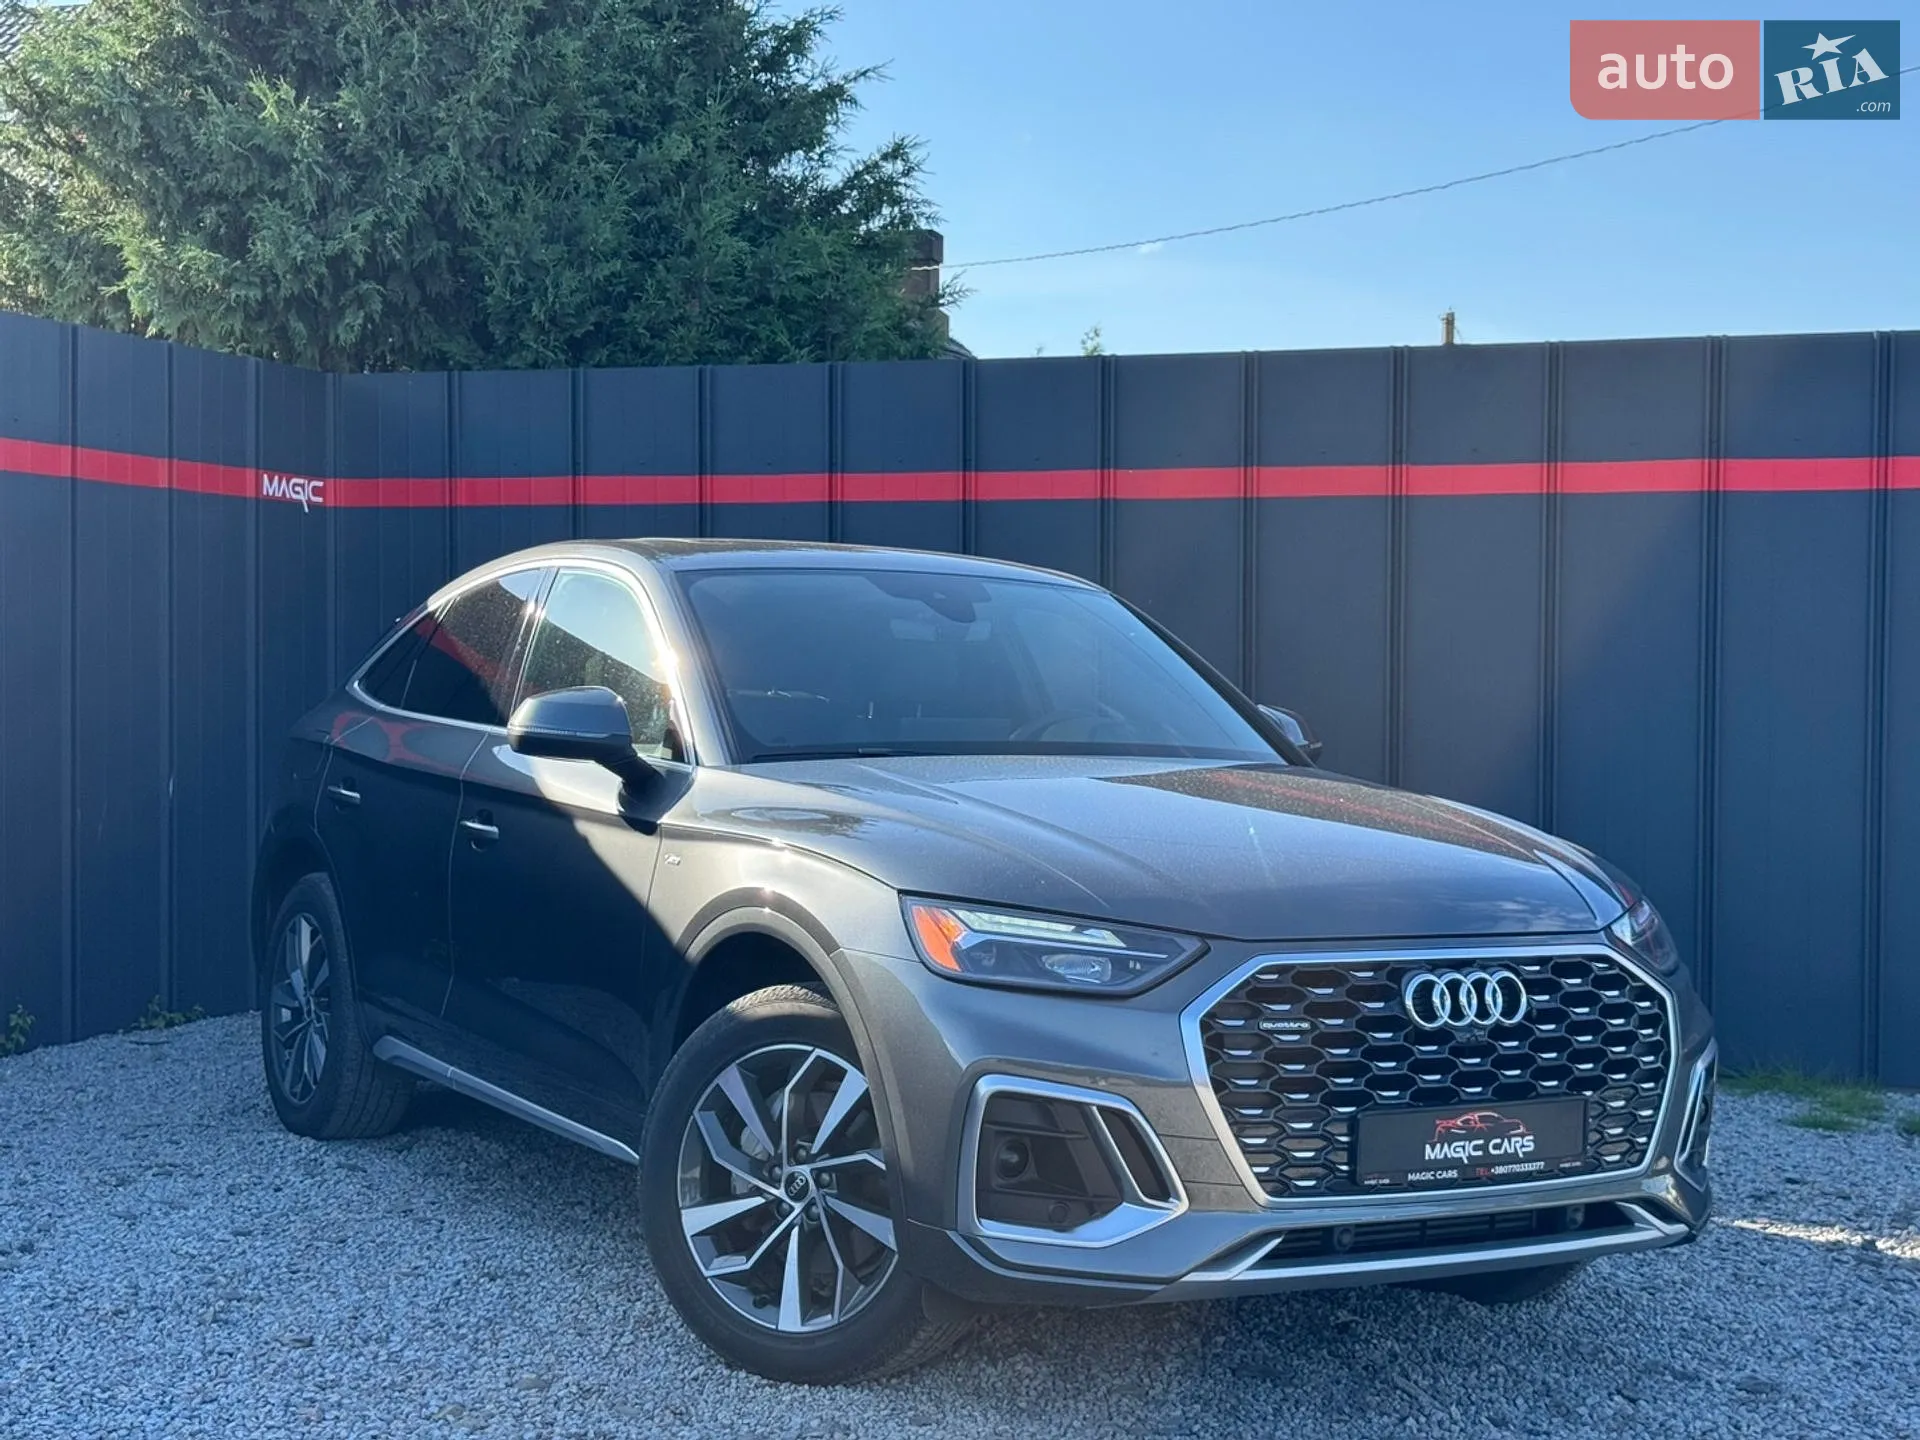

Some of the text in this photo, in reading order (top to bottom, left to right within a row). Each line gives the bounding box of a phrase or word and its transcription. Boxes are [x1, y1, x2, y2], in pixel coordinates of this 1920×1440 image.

[263, 474, 324, 512] MAGIC
[1425, 1135, 1535, 1164] MAGIC CARS
[1407, 1169, 1458, 1182] MAGIC CARS
